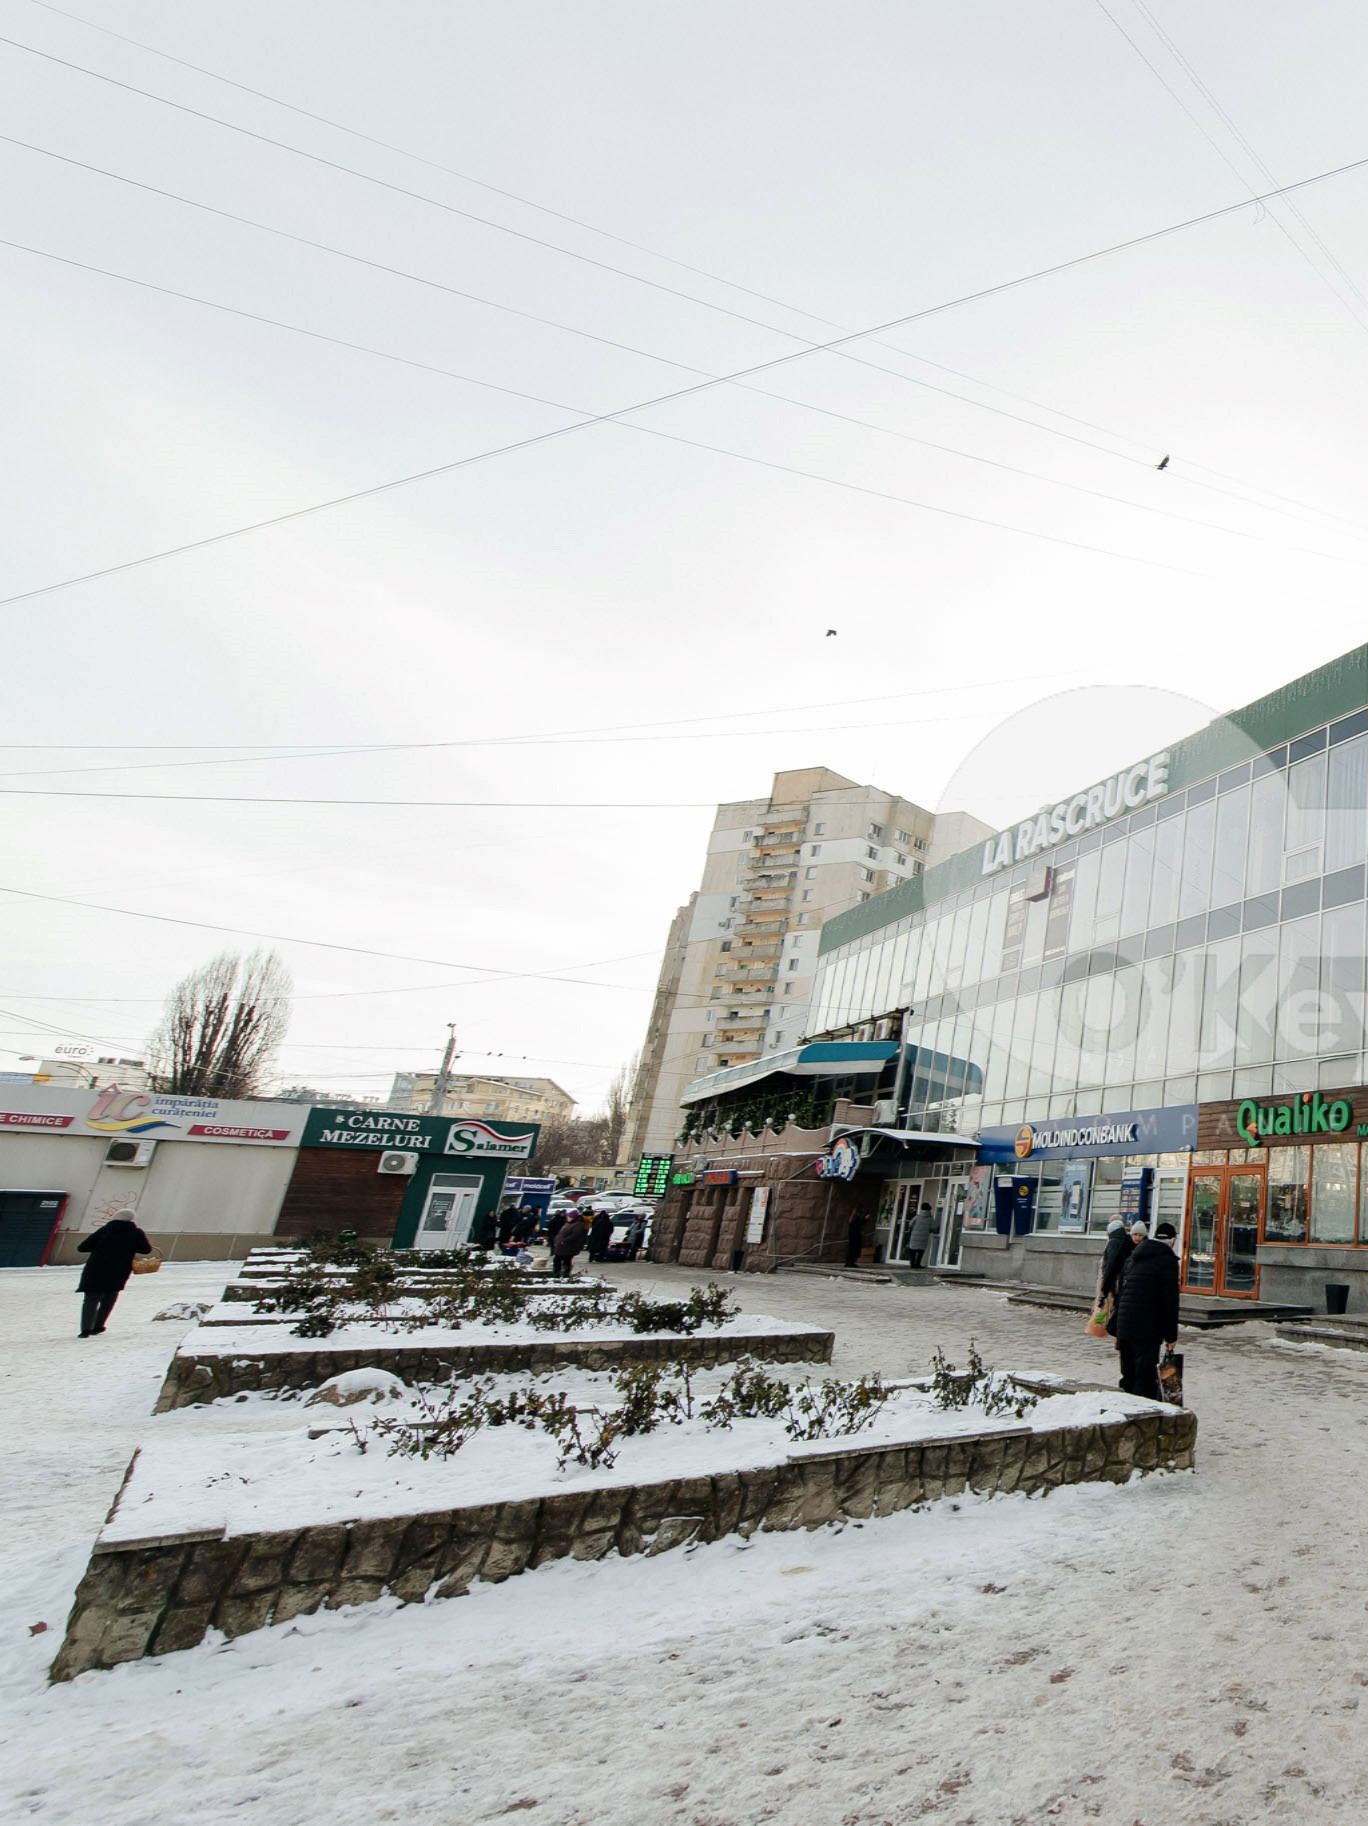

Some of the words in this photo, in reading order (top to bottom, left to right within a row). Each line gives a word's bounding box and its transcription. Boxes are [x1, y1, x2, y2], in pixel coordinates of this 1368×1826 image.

[981, 831, 1014, 876] LA
[55, 1046, 87, 1055] euro
[9, 1115, 64, 1126] CHIMICE
[348, 1115, 420, 1131] CARNE
[1236, 1091, 1352, 1146] Qualiko
[319, 1129, 433, 1148] MEZELURI
[448, 1129, 528, 1153] Salamer
